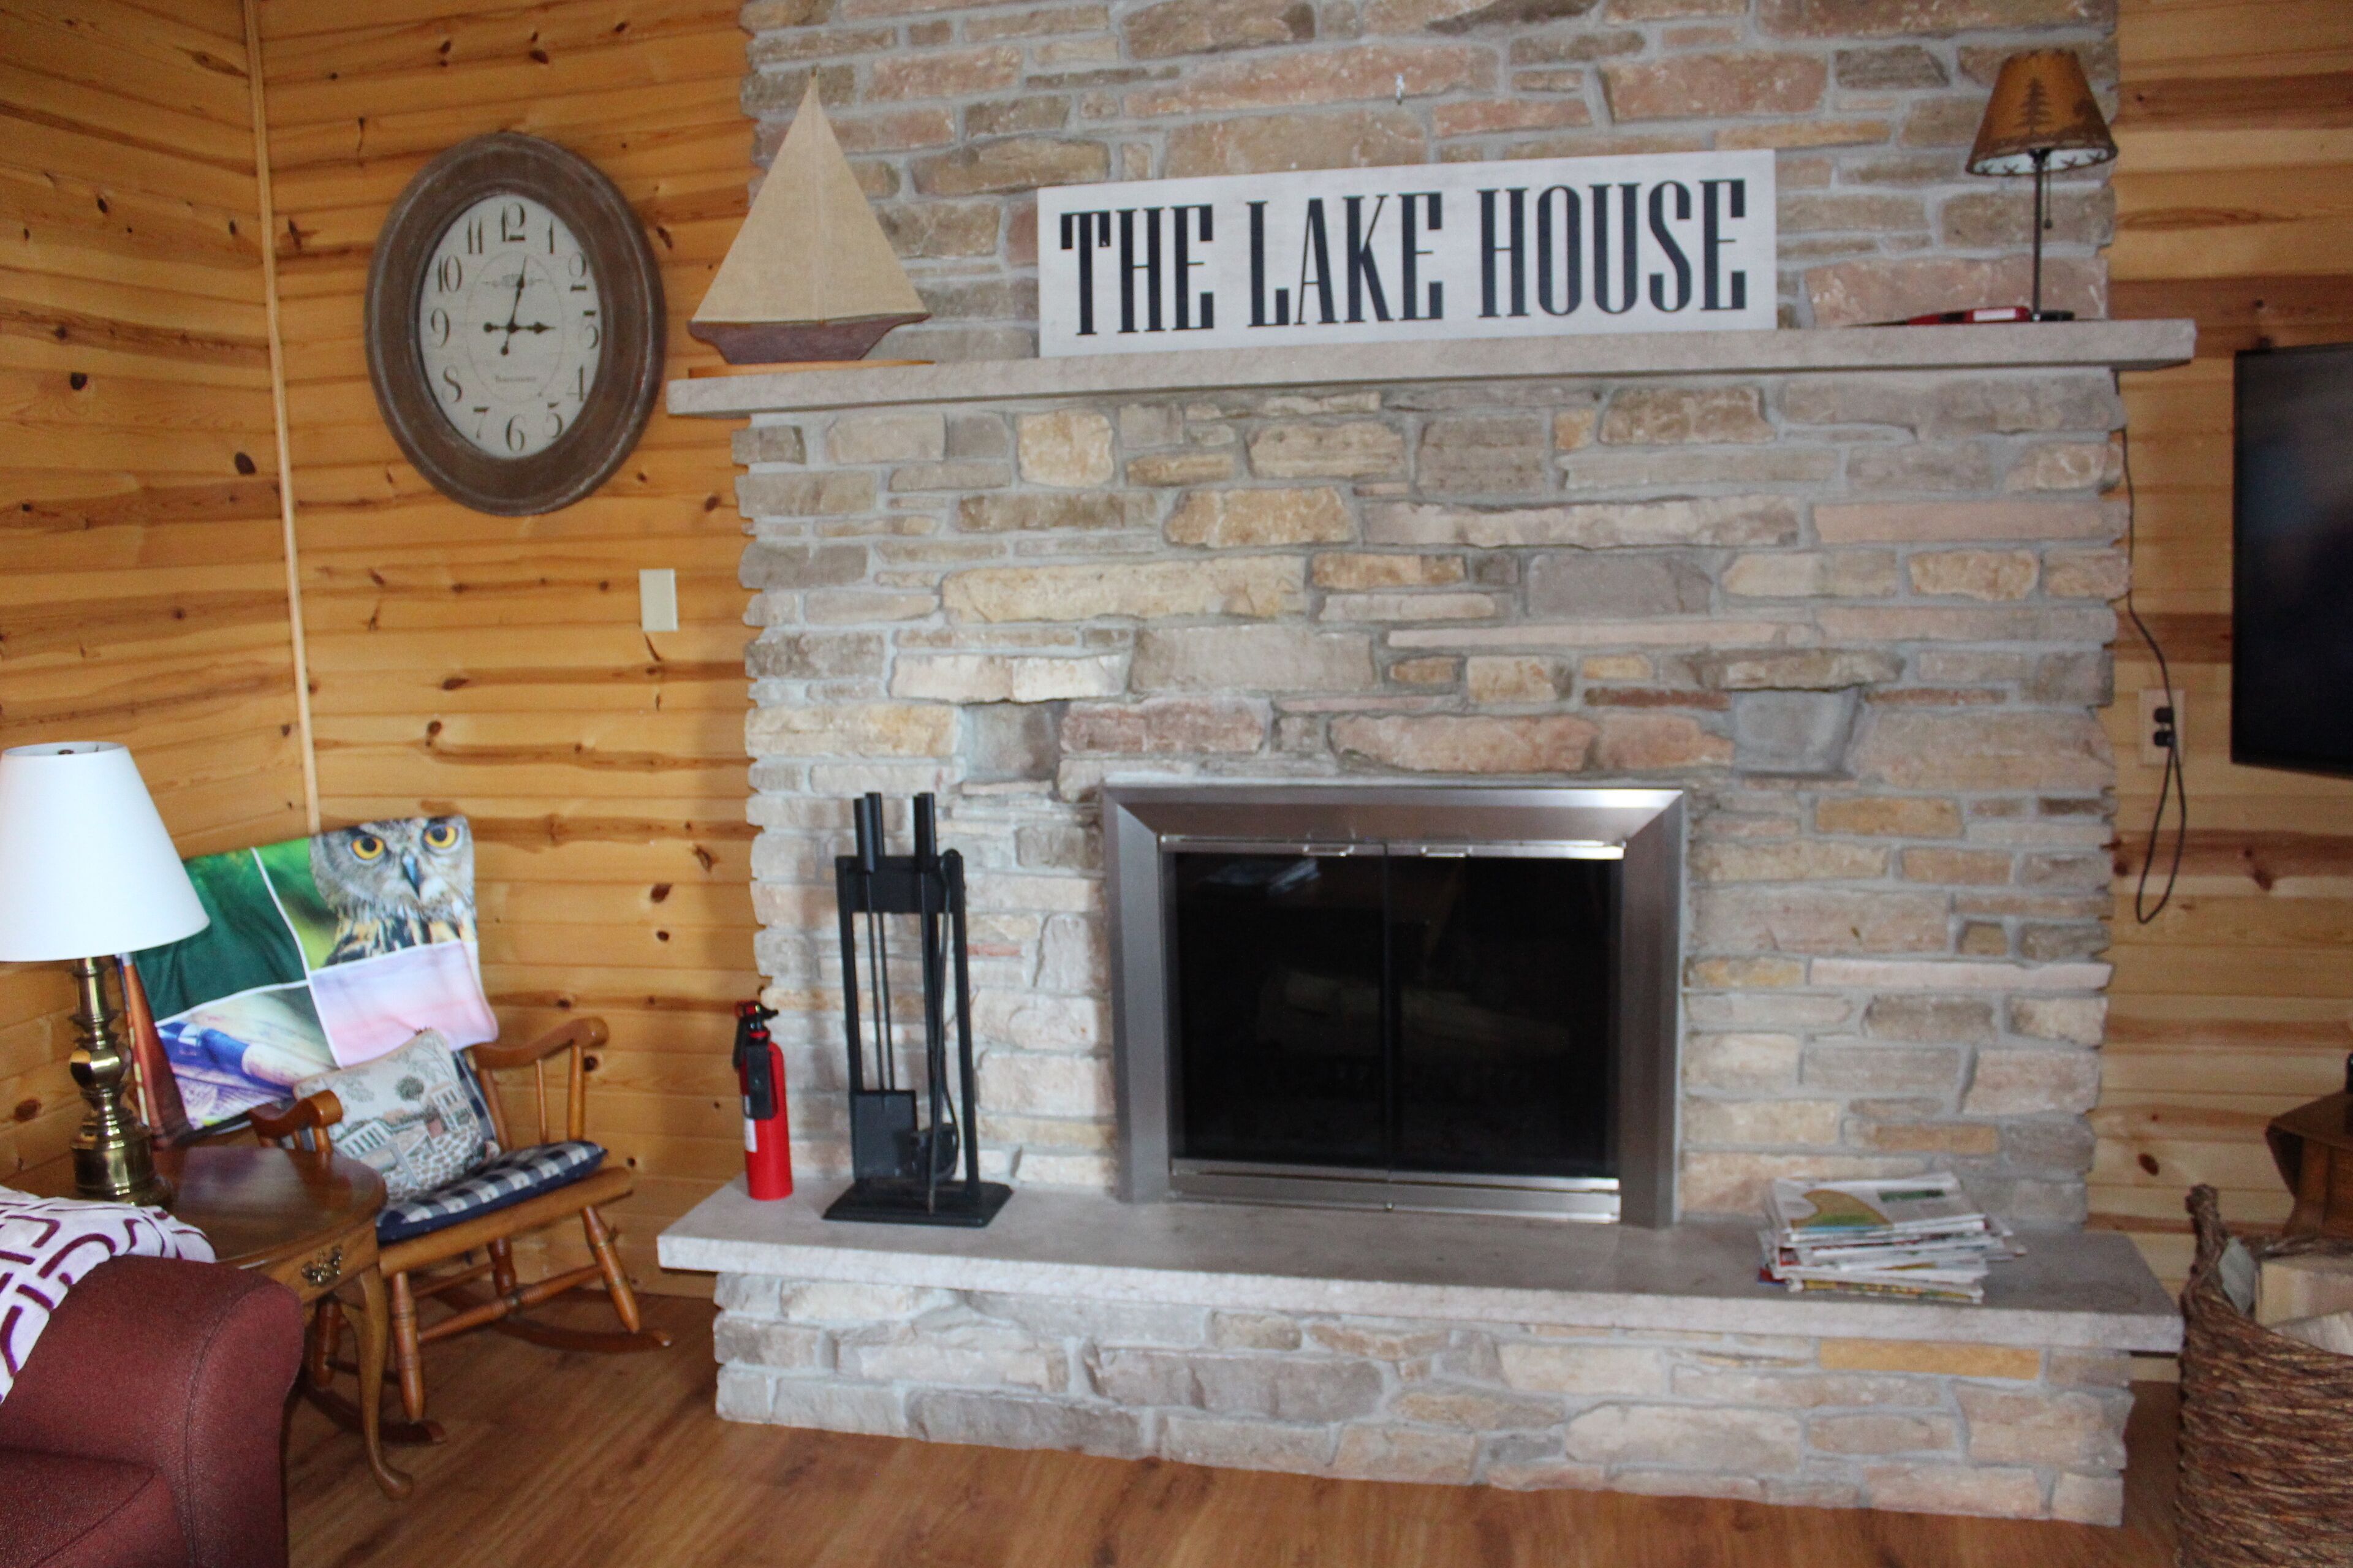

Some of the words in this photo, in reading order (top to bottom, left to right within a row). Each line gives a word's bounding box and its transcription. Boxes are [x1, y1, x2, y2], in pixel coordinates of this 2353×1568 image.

[467, 216, 483, 255] 11
[501, 202, 525, 243] 12
[548, 219, 554, 254] 1
[438, 254, 462, 294] 10
[567, 252, 588, 292] 2
[1060, 204, 1214, 335] THE
[1248, 192, 1444, 327] LAKE
[1476, 178, 1747, 318] HOUSE
[431, 308, 450, 348] 9
[441, 365, 463, 403] 8
[566, 365, 585, 403] 4
[472, 406, 490, 439] 7
[506, 414, 525, 452] 6
[542, 402, 563, 439] 5
